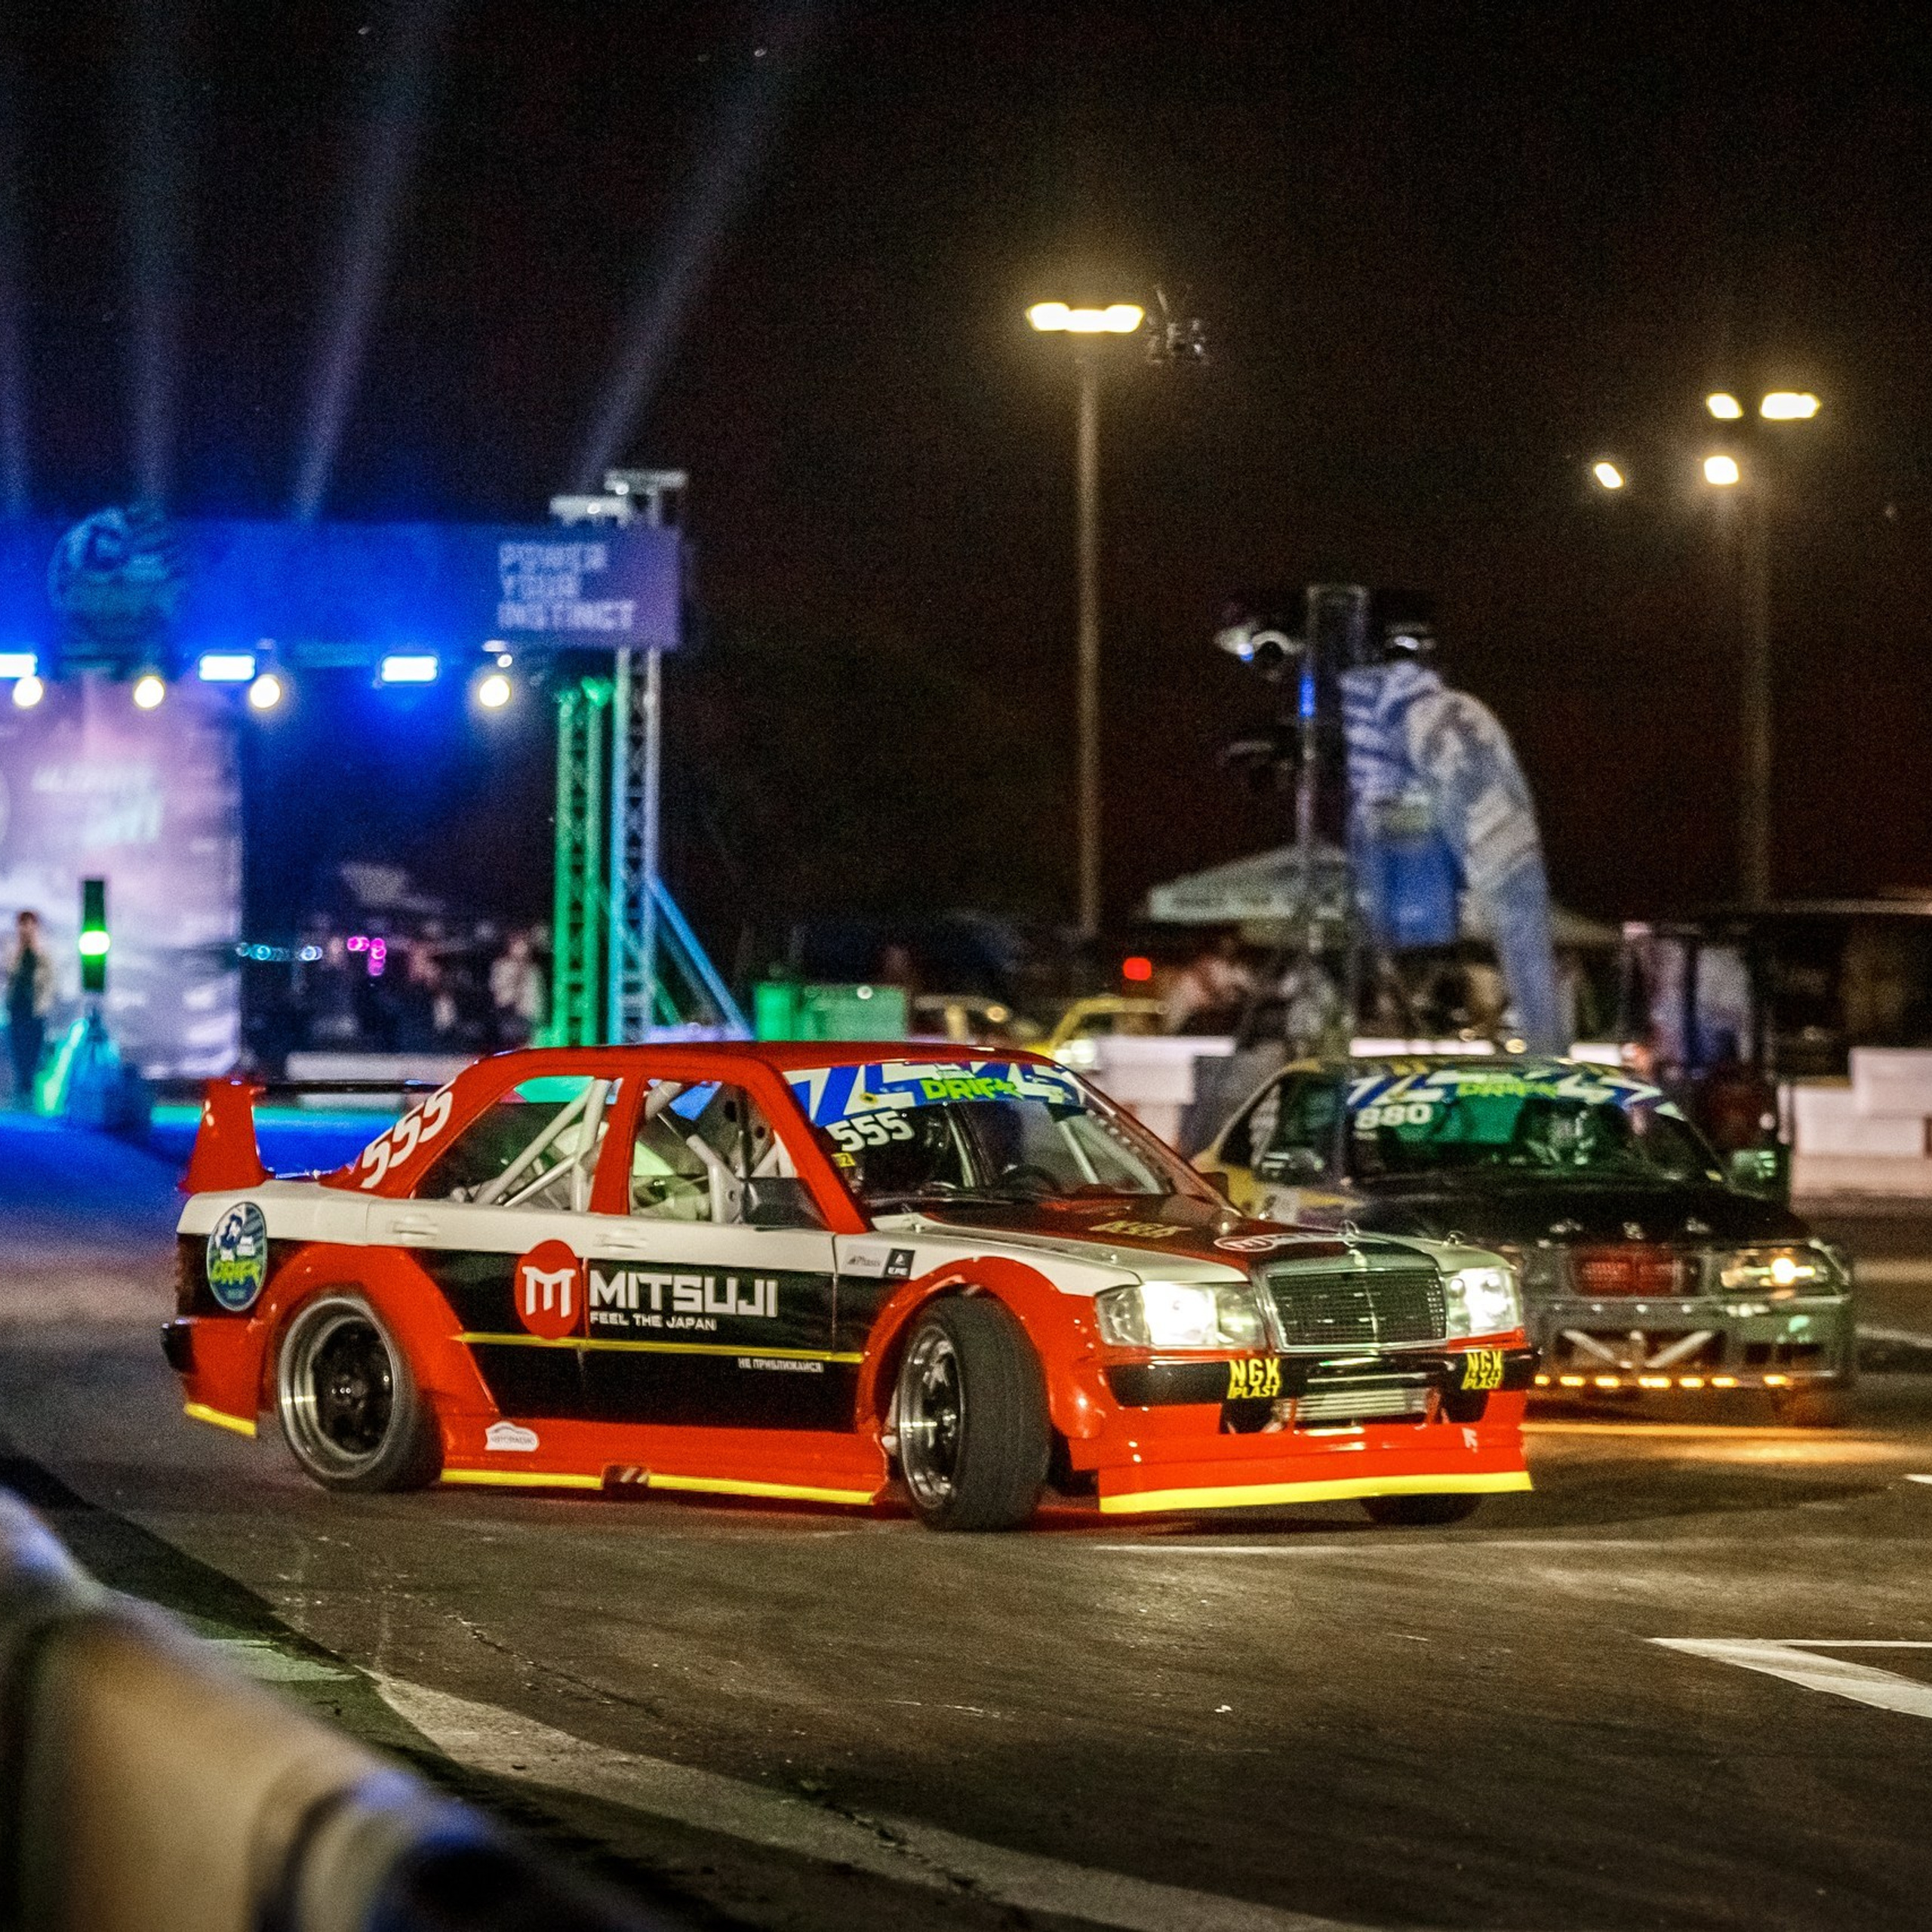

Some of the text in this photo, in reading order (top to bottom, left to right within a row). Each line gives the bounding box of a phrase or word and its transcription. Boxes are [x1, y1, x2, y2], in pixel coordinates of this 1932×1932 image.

[360, 1080, 454, 1189] 555
[825, 1110, 915, 1152] 555
[589, 1269, 778, 1318] MITSUJI
[589, 1311, 717, 1331] FEEL THE JAPAN
[1229, 1358, 1281, 1386] NGK
[1467, 1350, 1503, 1378] NGK
[1226, 1385, 1278, 1399] PLAST
[1460, 1377, 1501, 1389] PLAST
